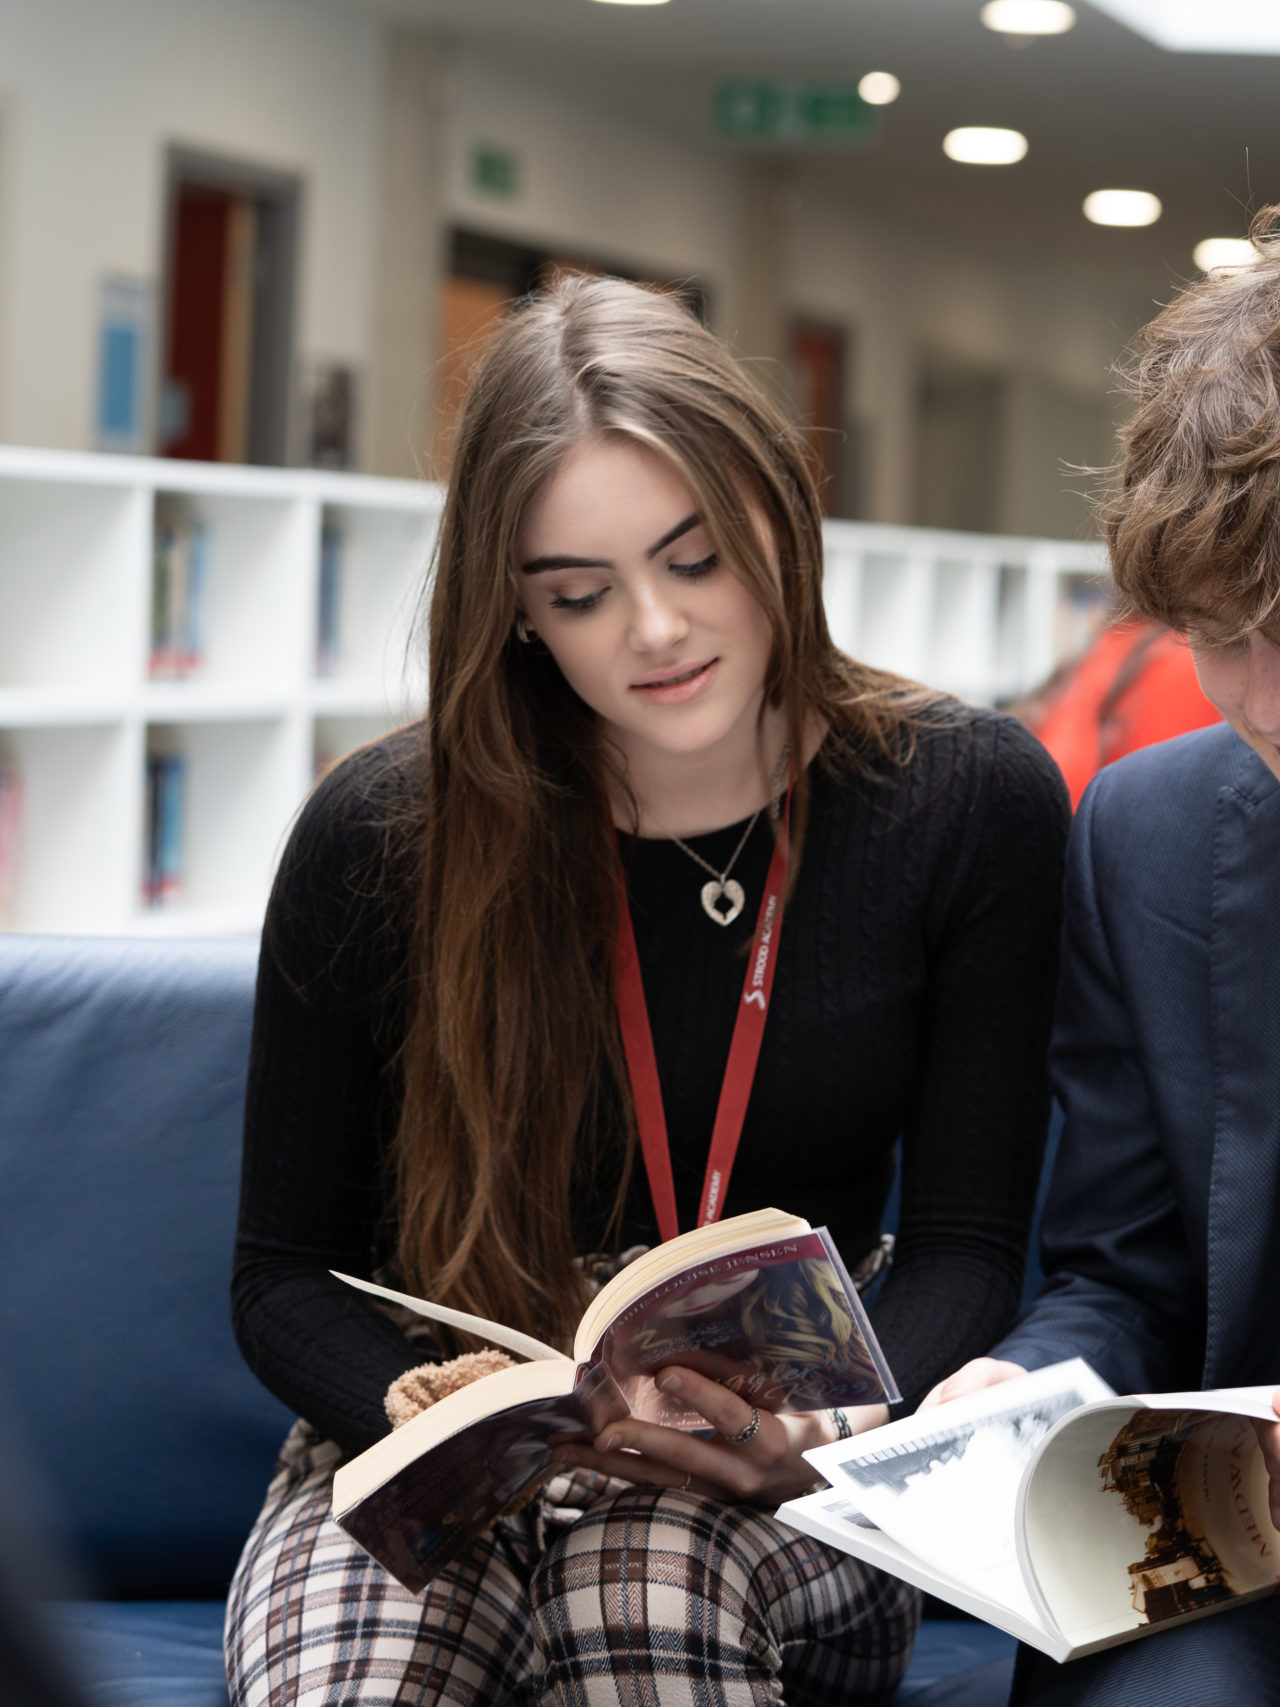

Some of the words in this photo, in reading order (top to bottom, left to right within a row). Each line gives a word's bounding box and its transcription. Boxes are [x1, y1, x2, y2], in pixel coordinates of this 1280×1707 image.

[752, 944, 770, 987] STROOD
[706, 1169, 722, 1220] ACADEMY
[1231, 1422, 1273, 1558] MEDWAY
